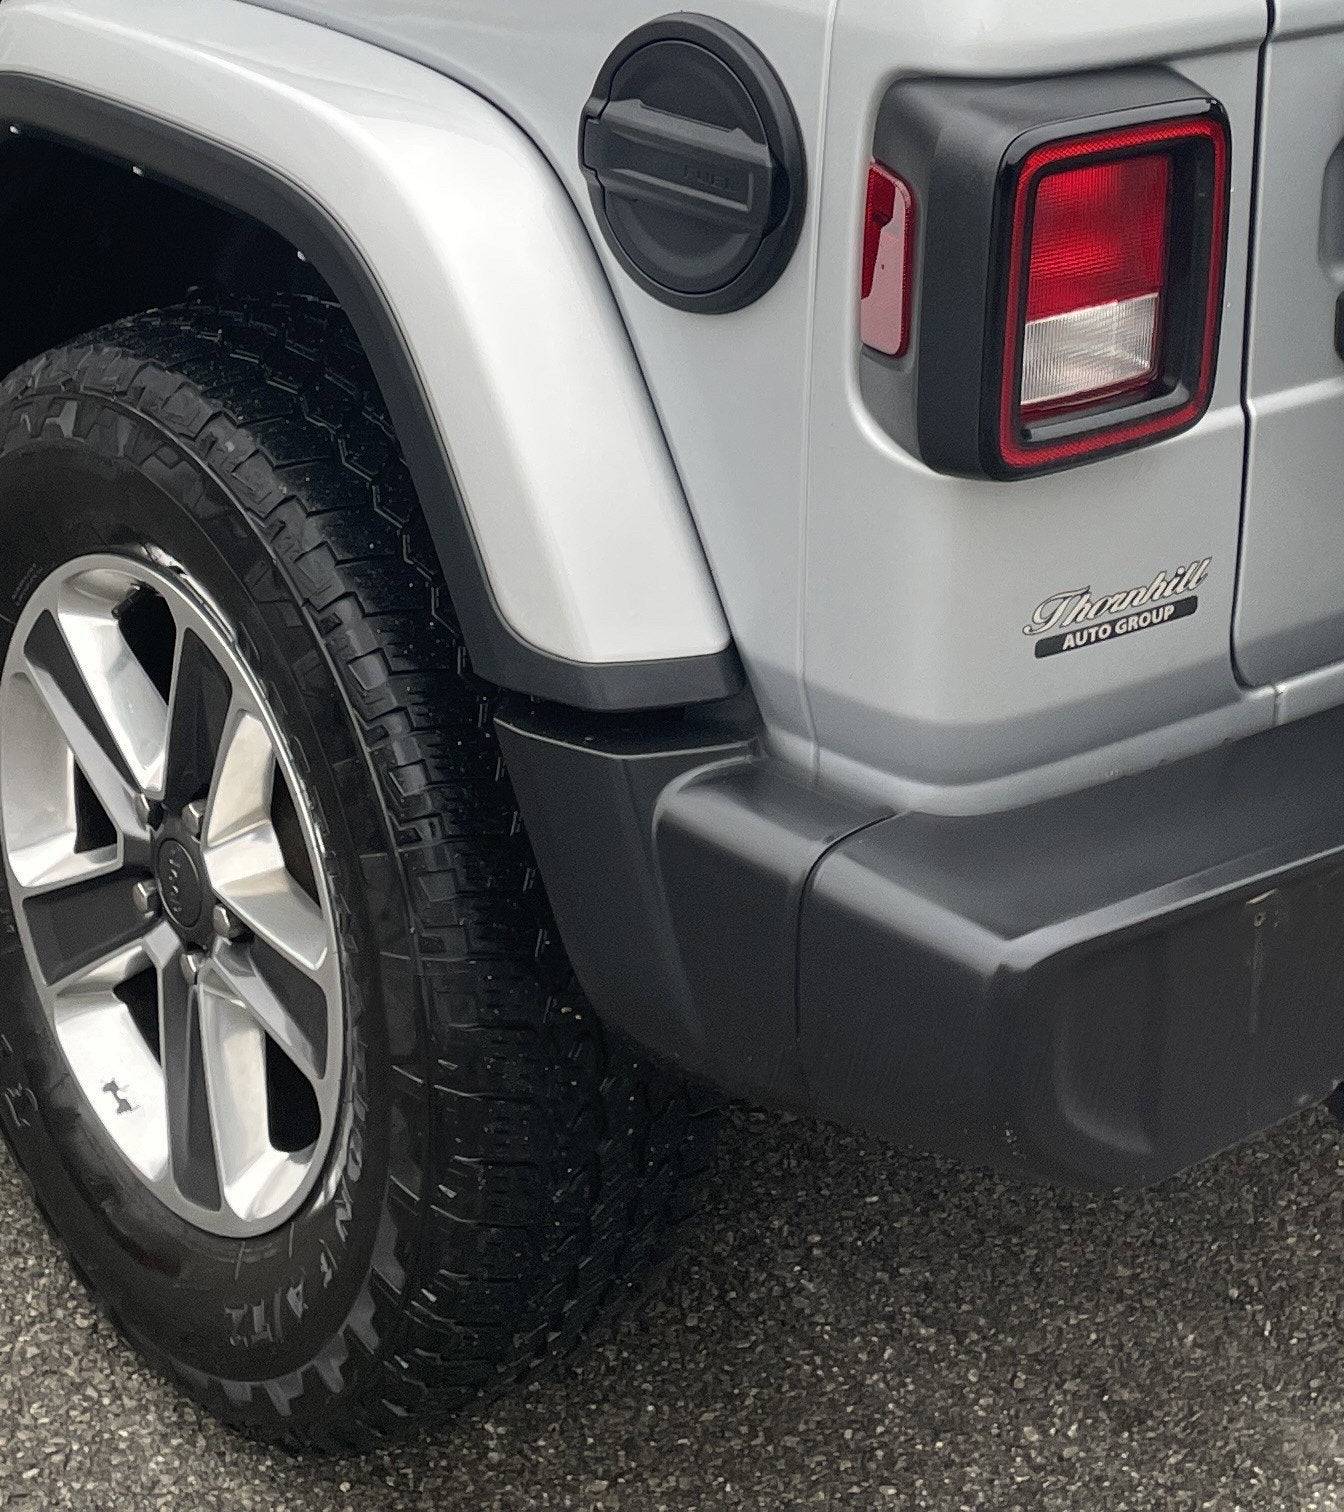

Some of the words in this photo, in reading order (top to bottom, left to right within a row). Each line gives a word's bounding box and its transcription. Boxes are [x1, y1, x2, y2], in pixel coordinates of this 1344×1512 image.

[1022, 555, 1213, 636] Thornhill
[1062, 624, 1112, 651] AUTO
[1114, 604, 1176, 634] GROUP
